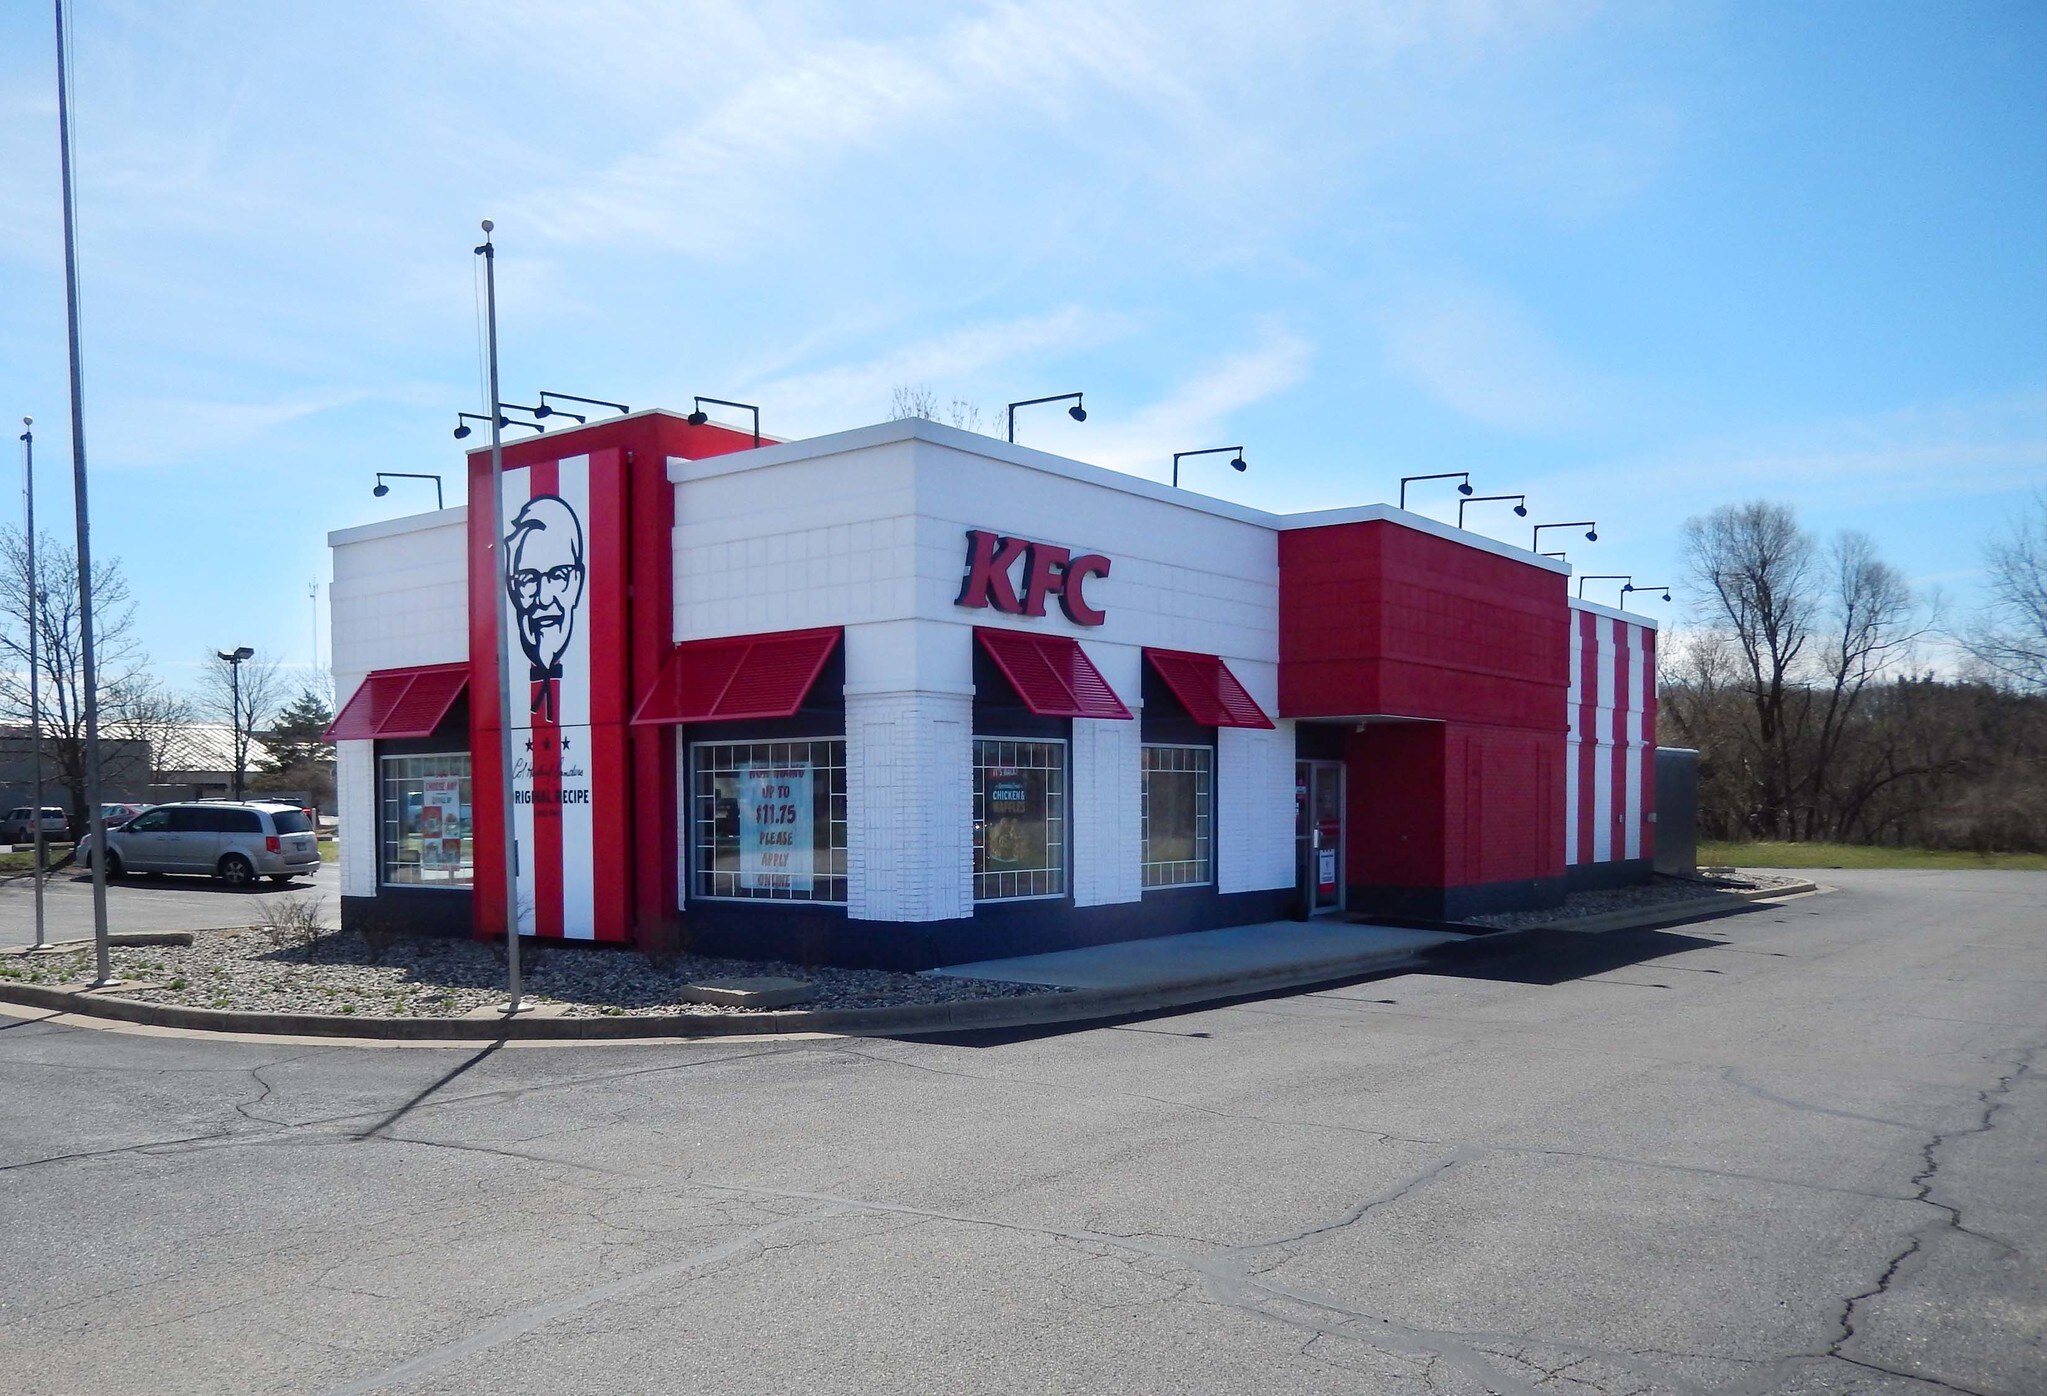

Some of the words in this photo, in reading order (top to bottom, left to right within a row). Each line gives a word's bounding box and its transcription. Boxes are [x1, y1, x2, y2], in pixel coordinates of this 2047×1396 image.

[954, 529, 1111, 626] KFC
[513, 789, 552, 804] RIGINAL
[555, 789, 590, 804] RECIPE
[762, 785, 774, 798] UP
[778, 786, 790, 798] TO
[756, 804, 796, 825] $11.75
[760, 831, 793, 846] PLEASE
[761, 852, 790, 867] APPLY
